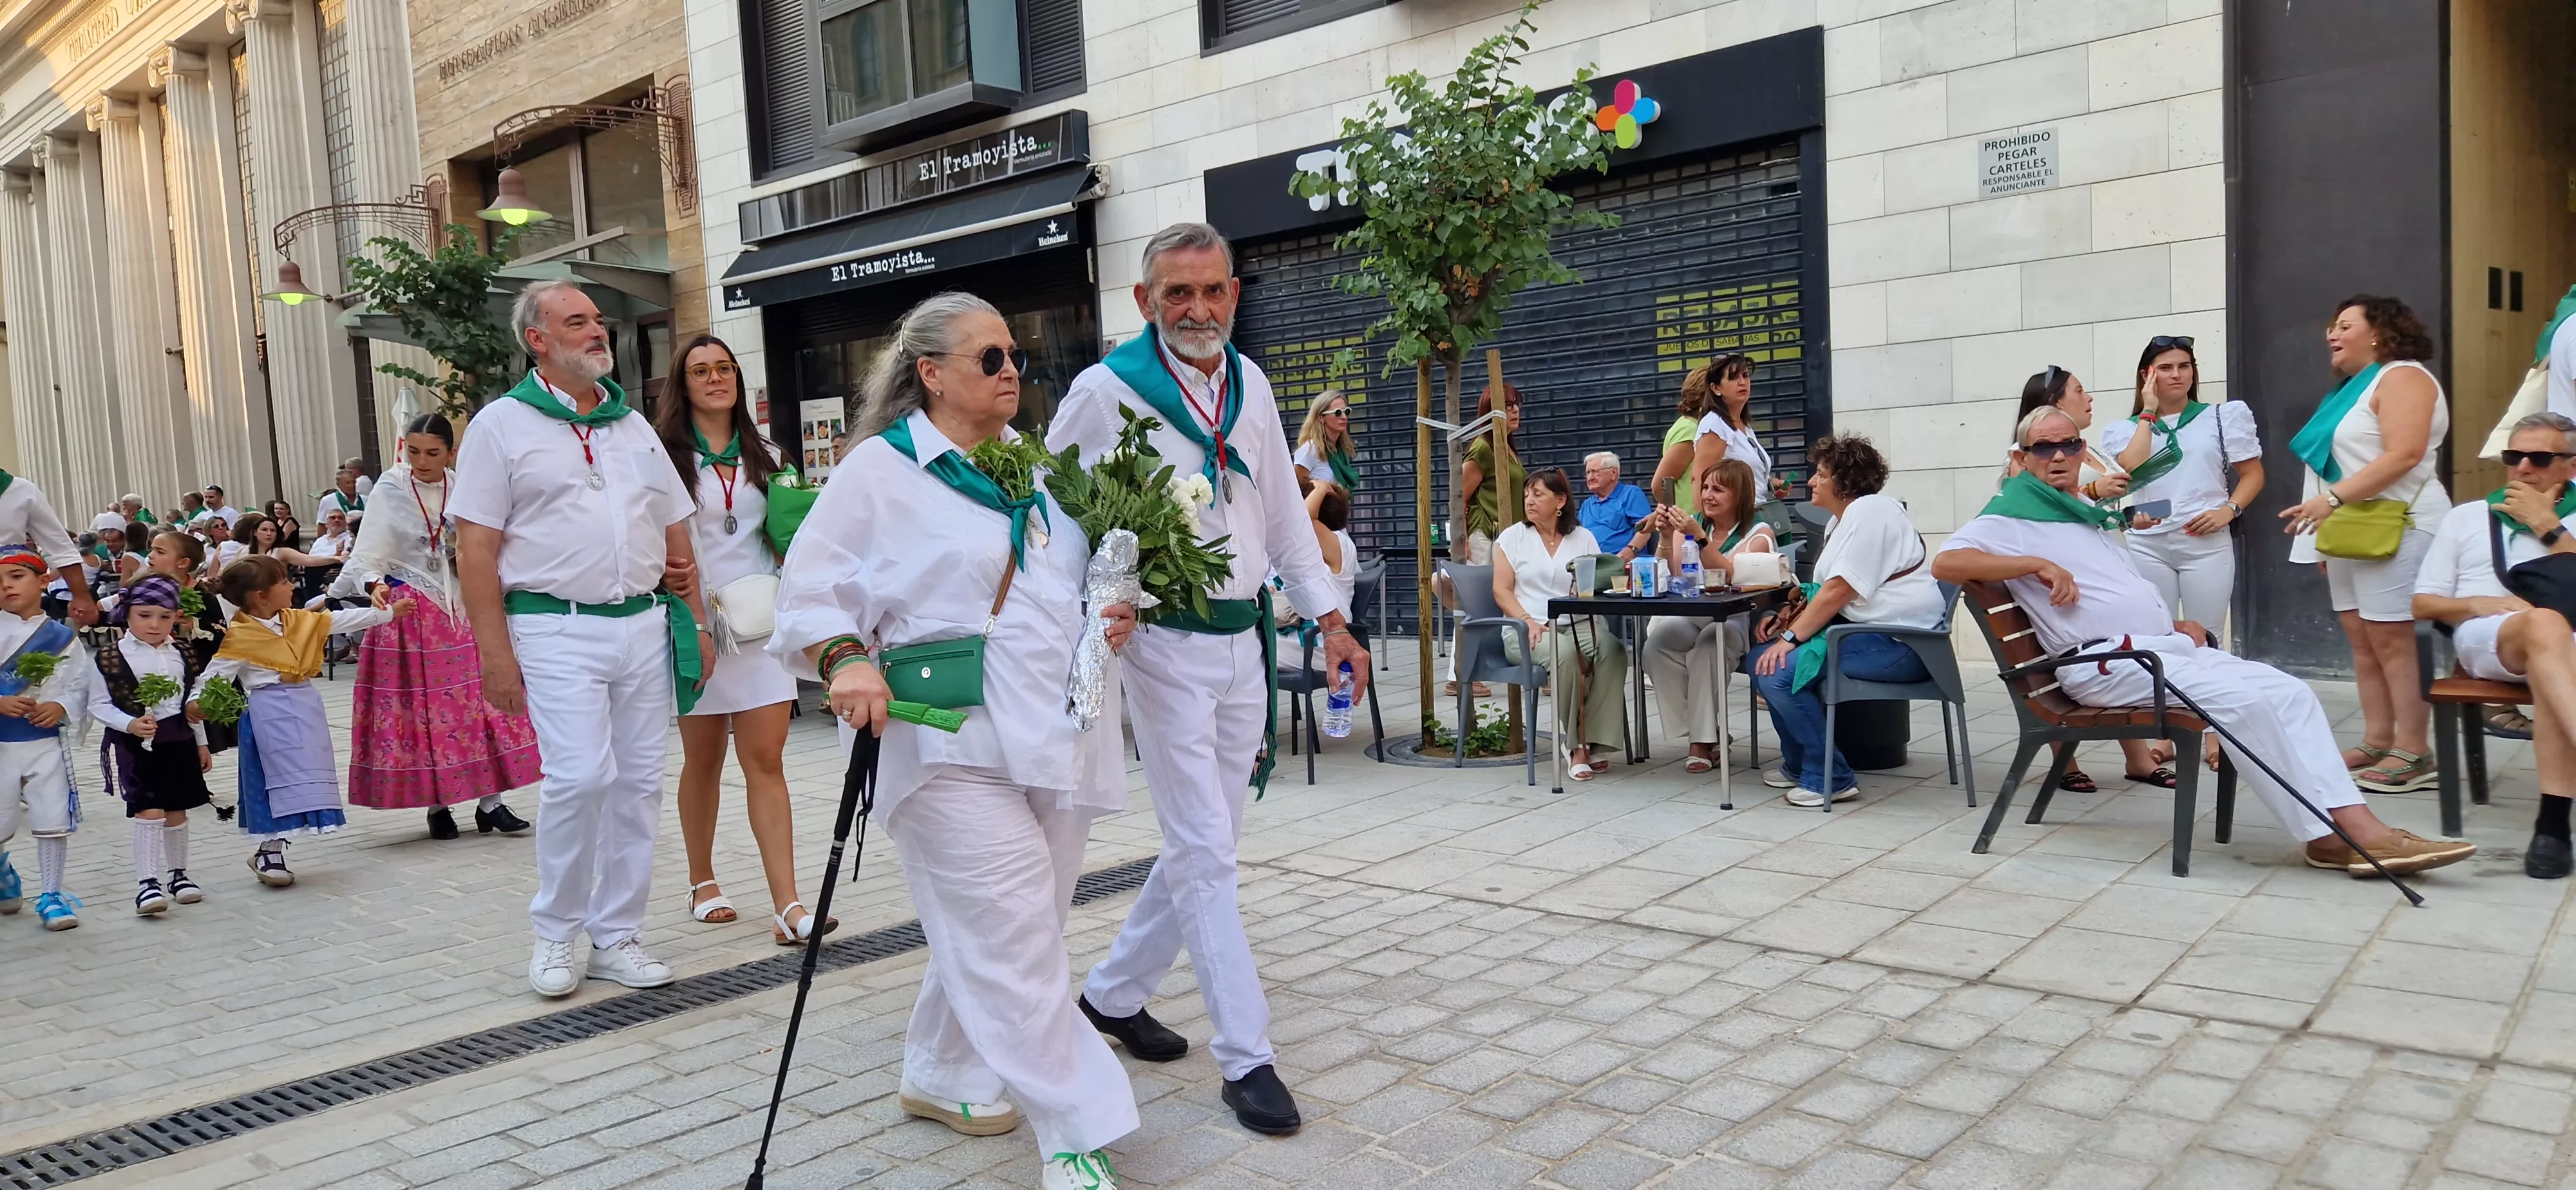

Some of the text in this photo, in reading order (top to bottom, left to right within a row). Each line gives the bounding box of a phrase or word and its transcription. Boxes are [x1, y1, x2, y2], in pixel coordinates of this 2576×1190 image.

[1984, 131, 2051, 151] PROHIBIDO
[1998, 146, 2037, 162] PEGAR
[918, 160, 938, 181] El
[1989, 157, 2047, 176] CARTELES
[1982, 170, 2041, 186] RESPONSABLE
[1990, 178, 2046, 194] ANUNCIANTE
[1038, 231, 1068, 247] Heineken
[831, 265, 848, 282] El
[1664, 339, 1700, 352] JUEOS
